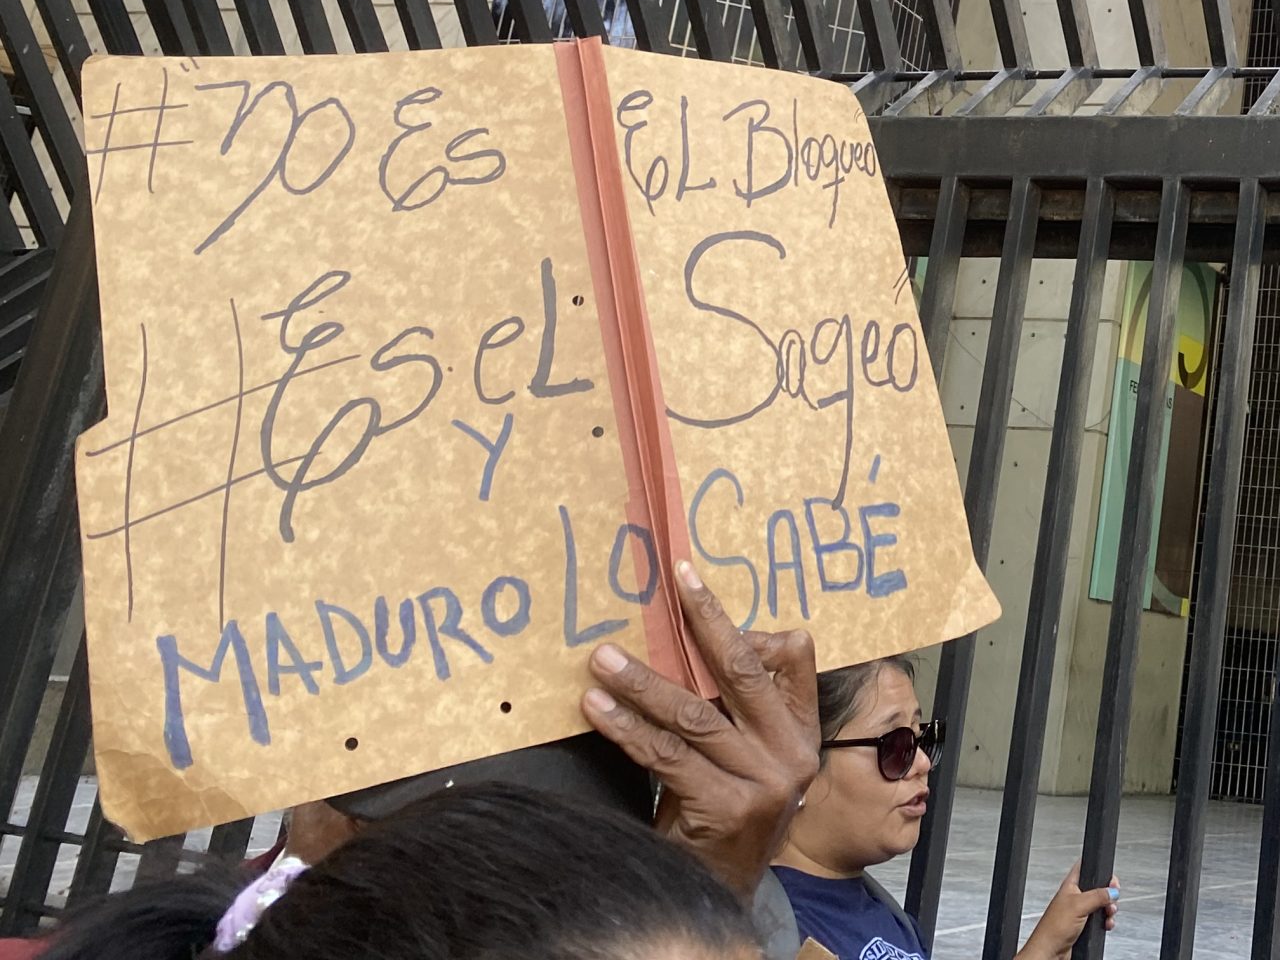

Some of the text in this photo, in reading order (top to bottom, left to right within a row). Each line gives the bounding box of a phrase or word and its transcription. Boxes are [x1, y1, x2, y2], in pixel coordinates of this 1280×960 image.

[379, 87, 506, 212] Es
[451, 413, 514, 501] Y
[155, 577, 532, 770] MADURO
[559, 505, 660, 648] LO
